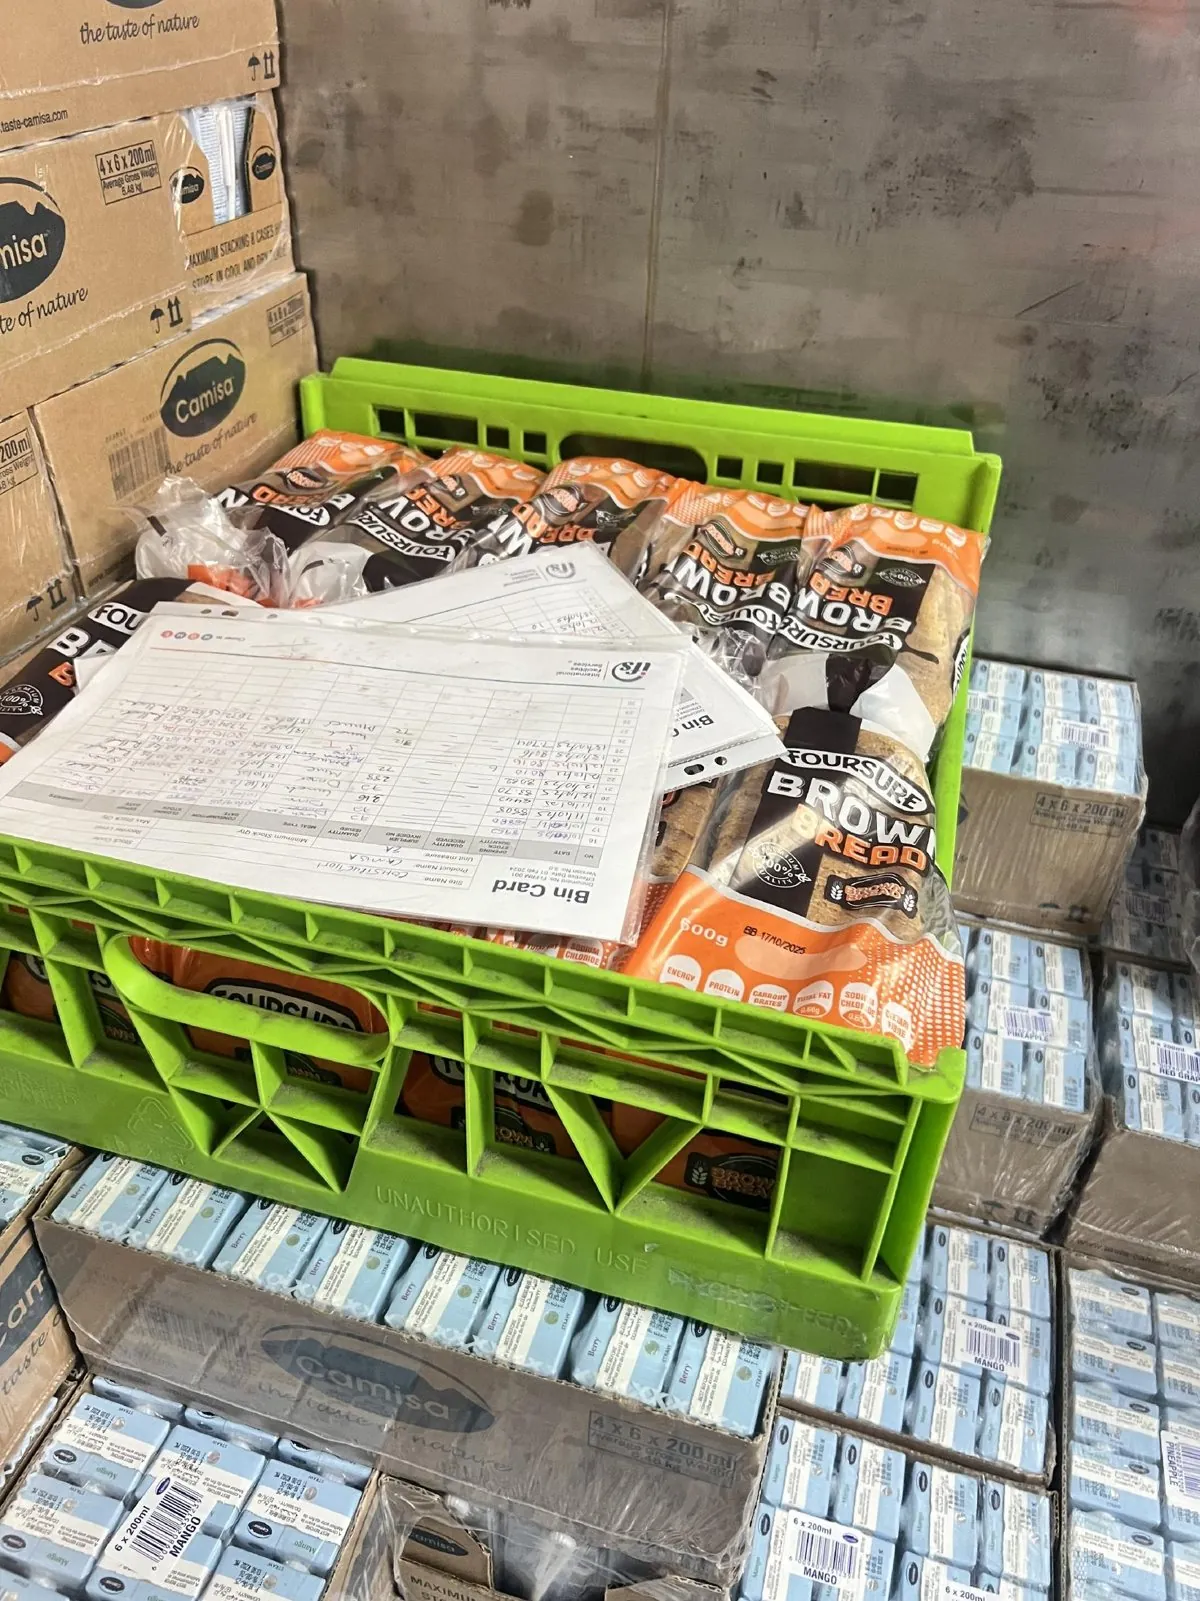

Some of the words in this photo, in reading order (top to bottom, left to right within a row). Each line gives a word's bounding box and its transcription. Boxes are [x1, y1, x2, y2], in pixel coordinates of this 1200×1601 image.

[80, 22, 105, 44] the
[106, 19, 139, 41] taste
[143, 13, 156, 36] of
[157, 15, 200, 36] nature
[100, 158, 106, 175] 4
[108, 163, 113, 173] x
[114, 154, 121, 172] 6
[122, 158, 128, 169] x
[129, 145, 155, 166] 200ml
[103, 173, 123, 189] Average
[124, 169, 140, 183] Gross
[220, 233, 250, 257] STACKING
[256, 225, 274, 241] CASES
[216, 269, 224, 281] IN
[225, 264, 241, 279] COOL
[18, 303, 35, 326] of
[38, 287, 88, 319] nature
[176, 377, 234, 424] Camisa
[184, 443, 211, 468] taste
[212, 434, 224, 454] of
[224, 412, 258, 446] nature
[810, 570, 893, 616] BREA
[799, 586, 912, 634] BROW
[616, 662, 651, 680] ifs
[682, 714, 714, 731] Bin
[787, 750, 923, 810] FOURSURE
[1037, 793, 1046, 807] 4
[1060, 799, 1069, 811] 6
[328, 829, 360, 838] QUANTITY
[791, 803, 927, 871] BREAD
[568, 874, 595, 882] Effective
[491, 879, 546, 898] Card
[553, 887, 590, 904] Bin
[680, 916, 729, 948] 600g
[744, 926, 757, 936] BB
[760, 932, 806, 955] 17/10/2025
[565, 951, 600, 966] CHLORIDE
[572, 942, 600, 955] SODIUM
[667, 966, 695, 982] ENERGY
[709, 981, 740, 997] PROTEIN
[1007, 1030, 1050, 1042] PINEAPPLE
[1159, 1068, 1177, 1078] RED
[711, 1166, 776, 1188] BROW
[70, 1182, 88, 1199] Berry
[145, 1206, 161, 1225] Berry
[230, 1231, 248, 1249] Berry
[375, 1184, 577, 1256] UNAUTHORISED
[594, 1245, 650, 1276] USE
[309, 1256, 326, 1278] Berry
[401, 1282, 416, 1302] Berry
[487, 1311, 502, 1332] Berry
[974, 1322, 997, 1334] 200ml
[588, 1337, 600, 1357] Berry
[973, 1355, 1006, 1372] MANGO
[679, 1363, 692, 1385] Berry
[296, 1356, 449, 1419] Camisa
[593, 1415, 604, 1429] 4
[612, 1423, 621, 1434] x
[630, 1427, 641, 1440] 6
[649, 1435, 658, 1446] x
[1165, 1441, 1179, 1488] PINEAPPLE
[113, 1542, 123, 1552] 6
[120, 1535, 129, 1544] x
[125, 1504, 150, 1536] 200ml
[168, 1514, 202, 1558] MANGO
[793, 1517, 799, 1525] 6
[807, 1522, 832, 1536] 200ml
[292, 1539, 317, 1554] Mango
[803, 1565, 838, 1586] MANGO
[411, 1575, 479, 1601] MAXIMU
[945, 1585, 951, 1594] 6
